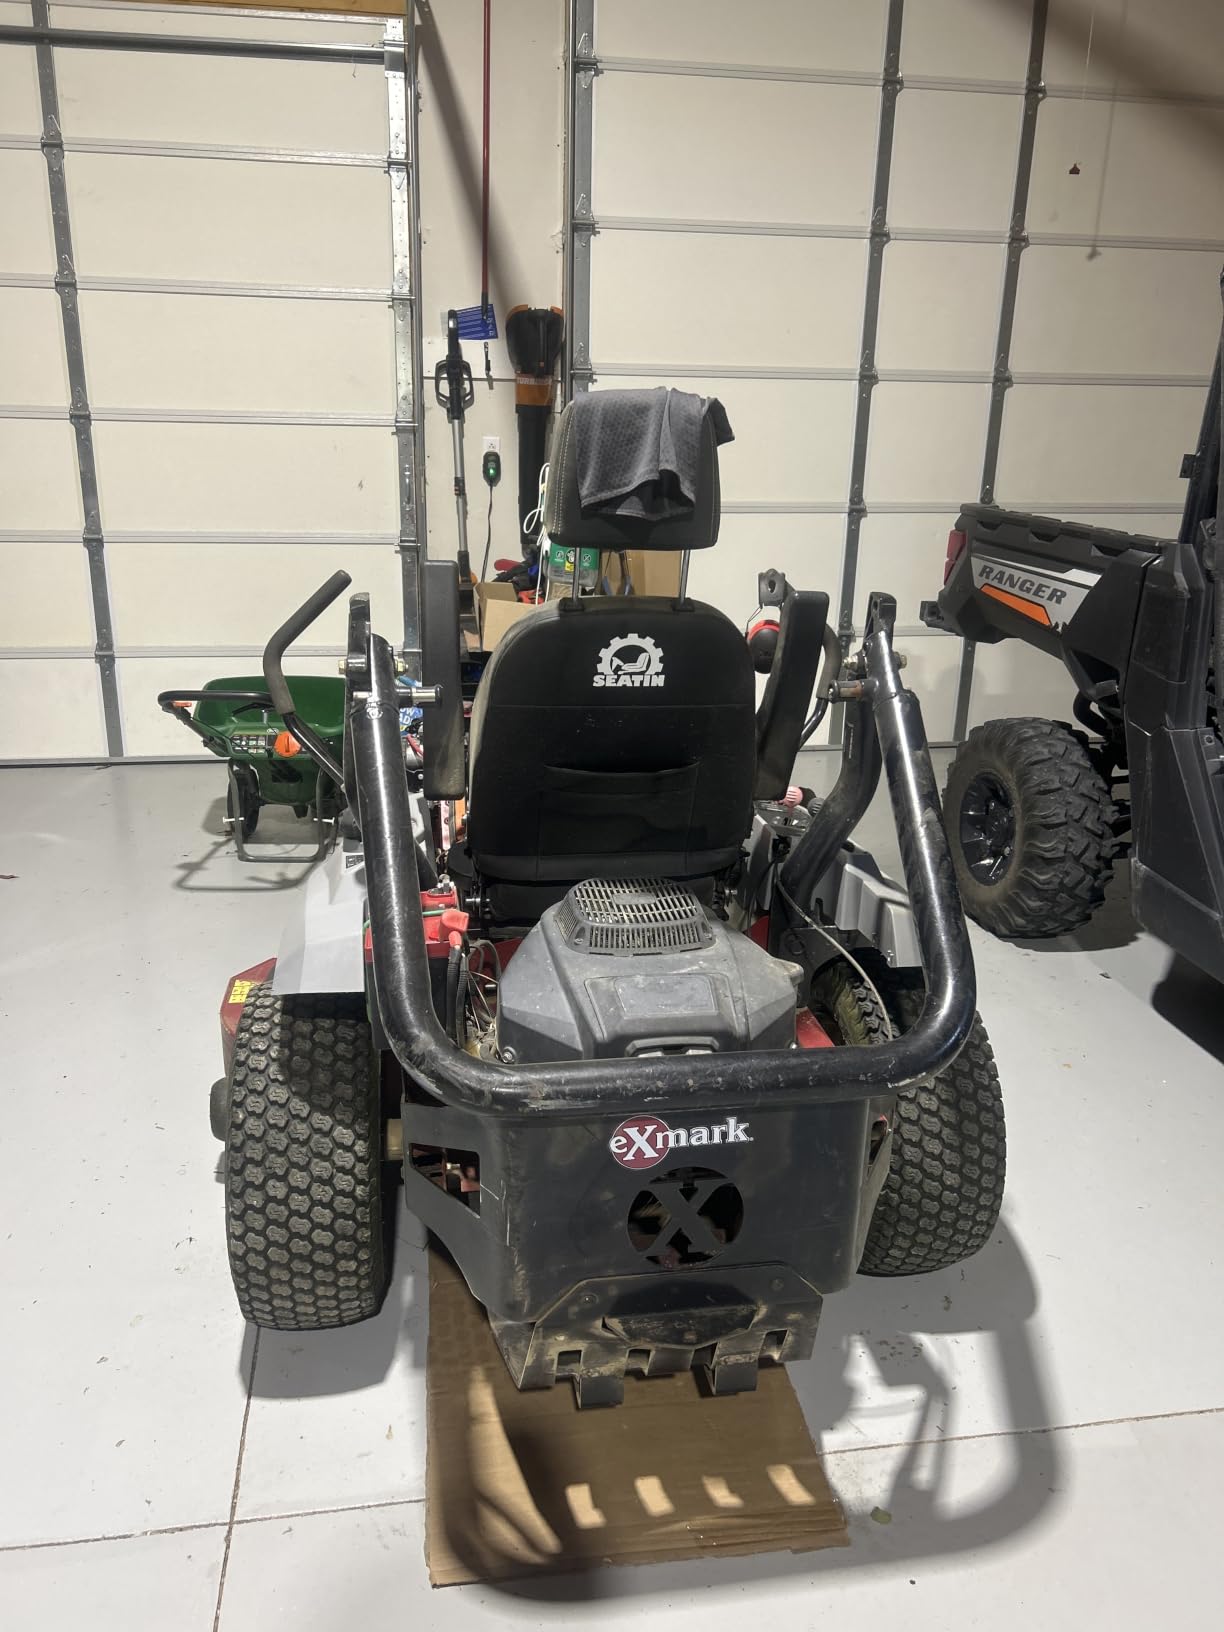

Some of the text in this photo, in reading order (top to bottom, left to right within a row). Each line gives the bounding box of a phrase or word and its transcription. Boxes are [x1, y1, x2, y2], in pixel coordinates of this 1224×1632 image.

[978, 564, 1067, 605] RANGER
[592, 674, 665, 687] SEATIN
[609, 1116, 754, 1161] eXmark
